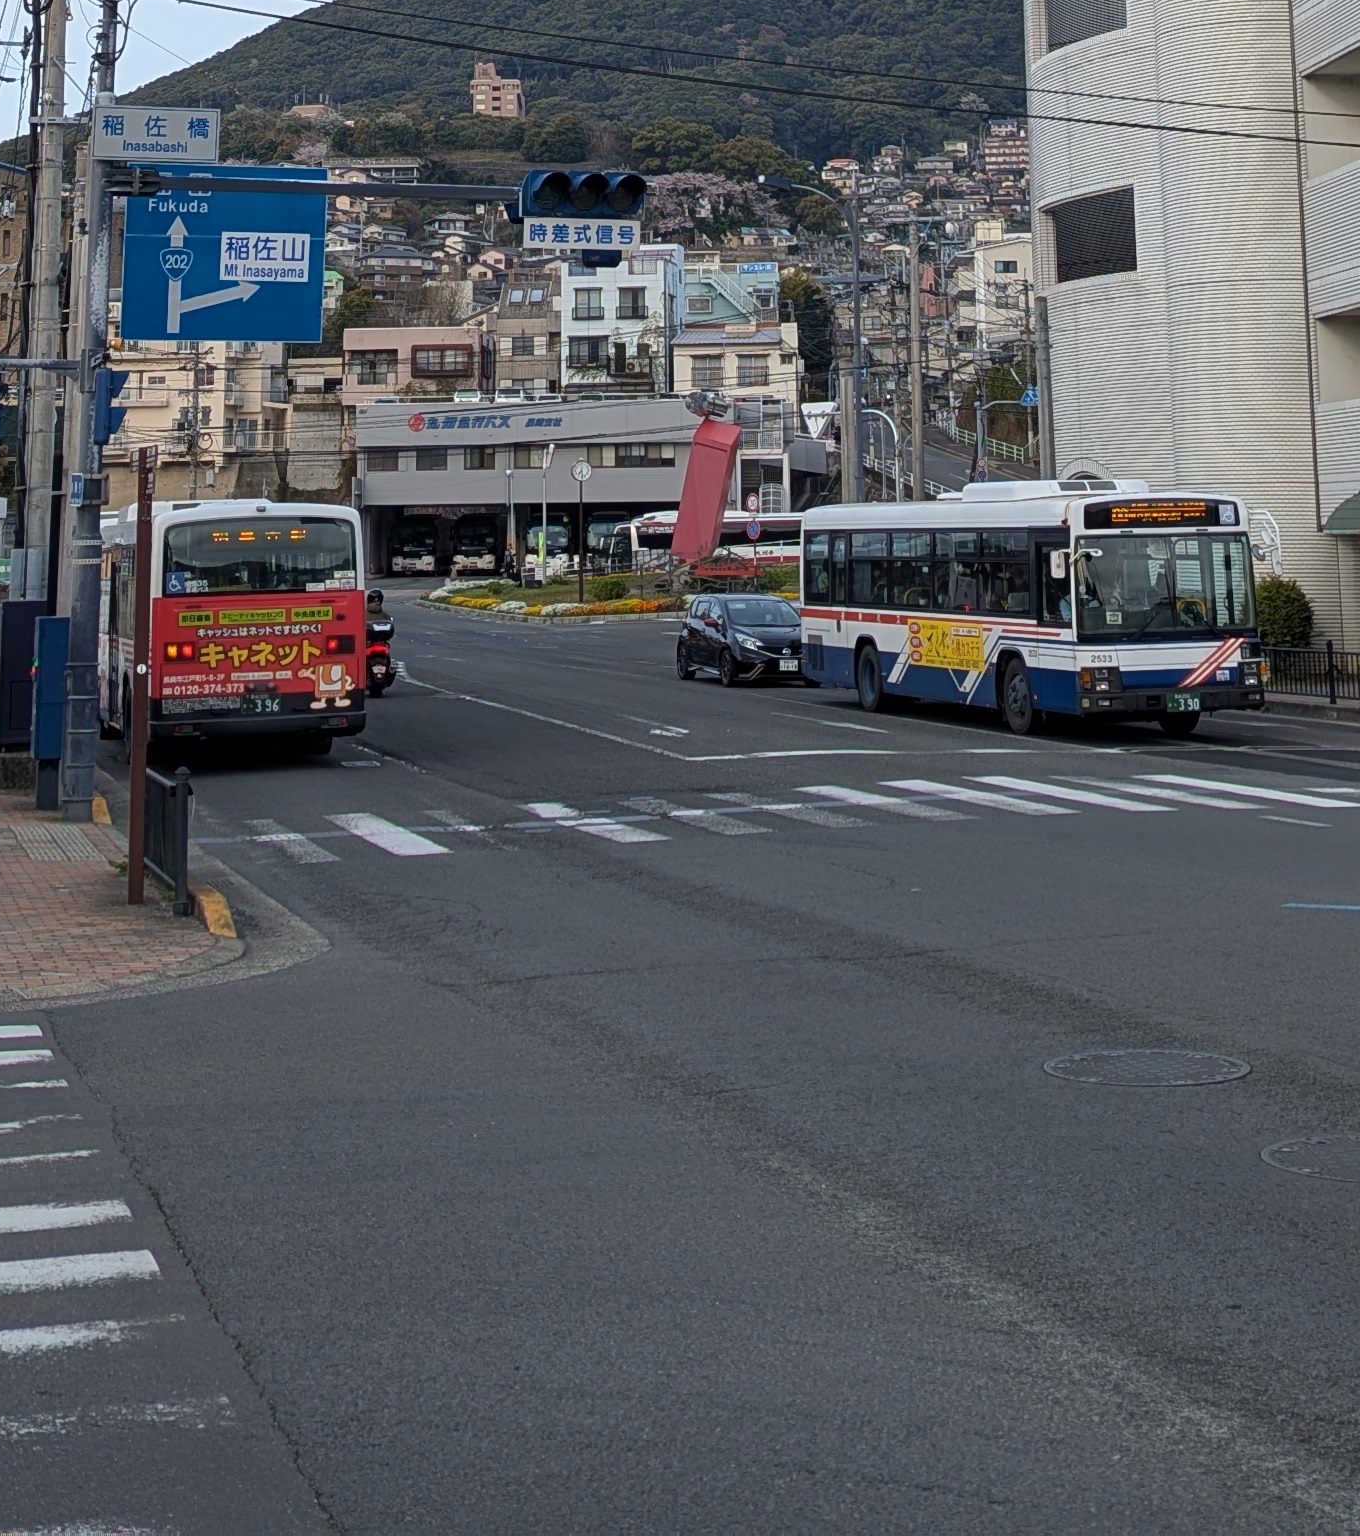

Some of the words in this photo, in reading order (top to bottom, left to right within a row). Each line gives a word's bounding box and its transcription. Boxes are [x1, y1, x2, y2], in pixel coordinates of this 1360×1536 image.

[102, 114, 210, 139] 稲佐橋
[122, 140, 188, 153] Inasabashi
[148, 198, 209, 213] Fukuda
[529, 222, 635, 245] 時差式信号
[224, 235, 306, 262] 稲佐山
[165, 254, 188, 269] 202
[242, 264, 305, 280] Inasayama
[200, 639, 322, 668] キャネット
[174, 683, 245, 696] 0120-374-373
[255, 699, 280, 712] 396
[1178, 698, 1200, 711] 390
